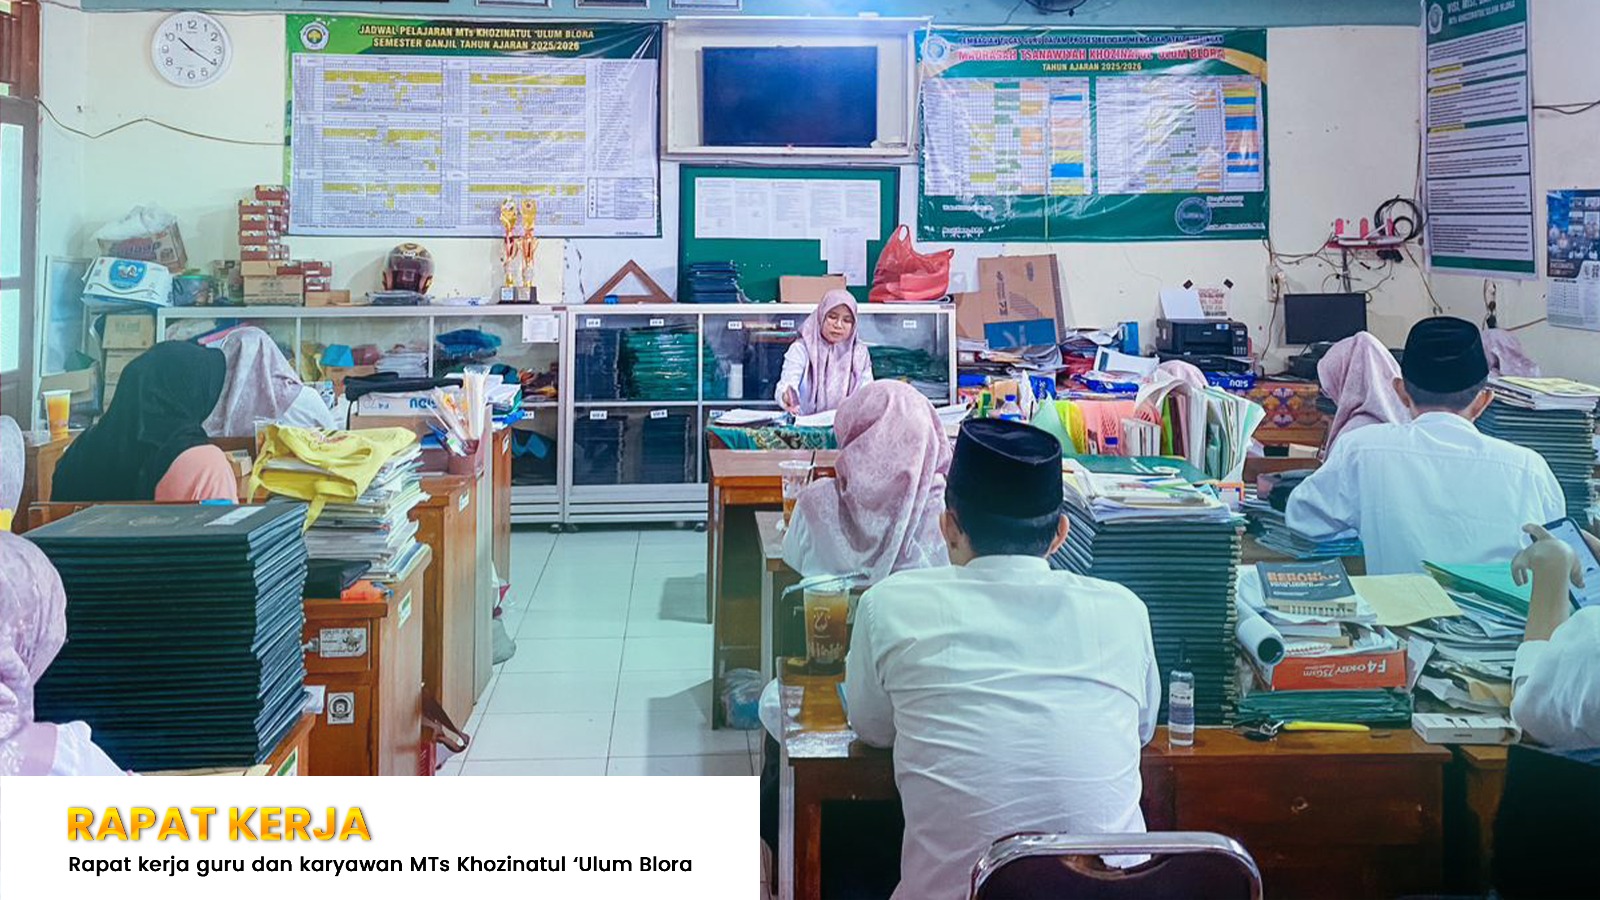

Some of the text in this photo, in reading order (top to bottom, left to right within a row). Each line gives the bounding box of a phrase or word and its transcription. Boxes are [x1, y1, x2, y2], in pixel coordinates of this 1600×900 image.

[175, 23, 183, 32] 11
[187, 20, 197, 29] 12
[203, 23, 208, 32] 1
[211, 32, 218, 41] 2
[359, 25, 397, 35] JADWAL
[400, 26, 453, 37] PELAJARAN
[455, 28, 475, 37] MTs
[476, 28, 532, 38] KHOZINATUL
[565, 30, 594, 39] BLORA
[165, 32, 175, 42] 10
[373, 38, 580, 51] SEMESTER GANJIL TAHUN AJARAN 2025/2026
[162, 45, 169, 54] 9
[214, 45, 222, 55] 3
[958, 49, 1018, 60] MADRASAH
[1020, 48, 1087, 60] TSANAWIYAH
[1089, 48, 1153, 60] KHOZINATUL
[1189, 48, 1226, 60] BLORA
[165, 57, 173, 66] 8
[1042, 62, 1142, 71] TAHUN AJARAN 2025/2026
[175, 67, 183, 76] 7
[187, 70, 195, 79] 6
[200, 67, 208, 77] 5
[1367, 659, 1387, 673] F4
